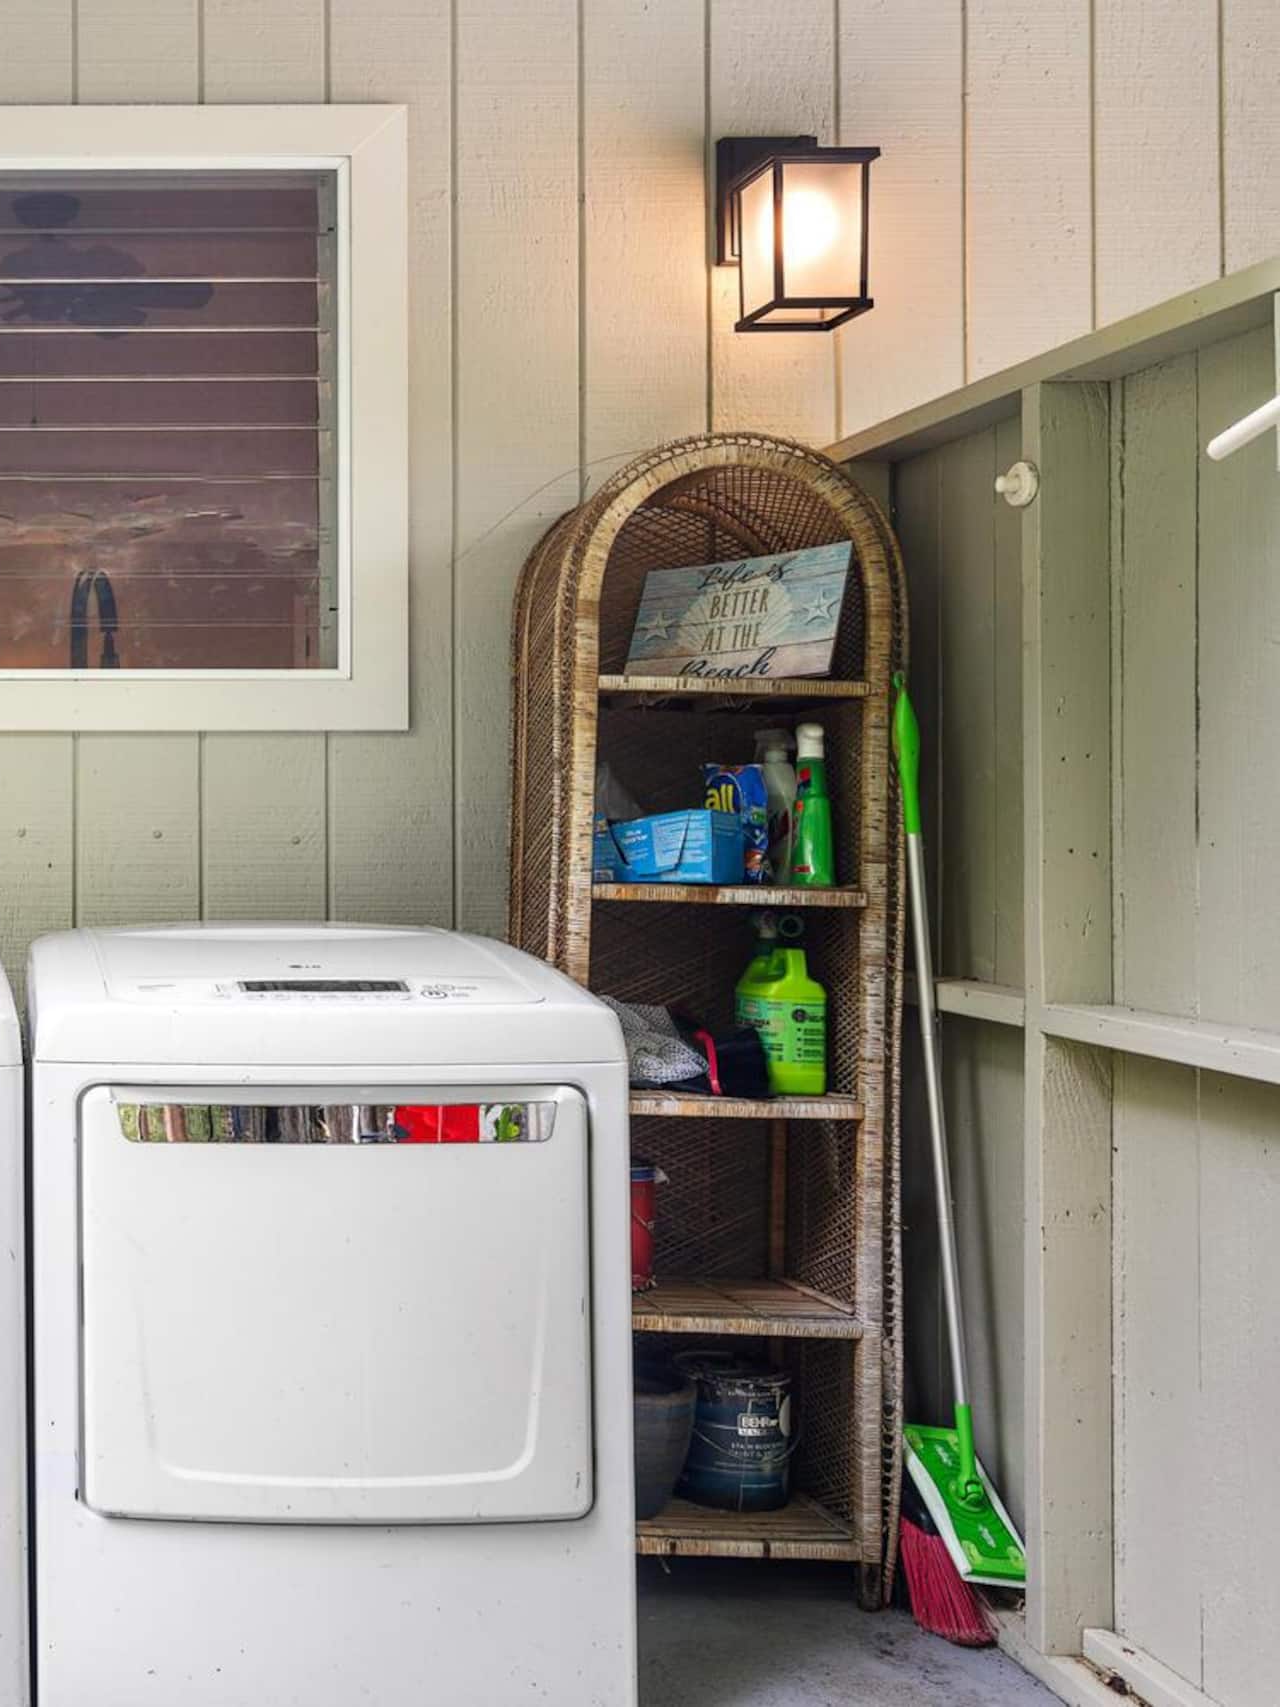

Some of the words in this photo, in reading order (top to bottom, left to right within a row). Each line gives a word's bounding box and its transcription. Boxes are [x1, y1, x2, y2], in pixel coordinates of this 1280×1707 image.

[696, 562, 754, 591] Life
[764, 556, 798, 582] is
[709, 587, 769, 620] BETTER
[701, 625, 726, 651] AT
[733, 622, 762, 649] THE
[679, 647, 777, 679] Beach
[704, 783, 735, 814] all
